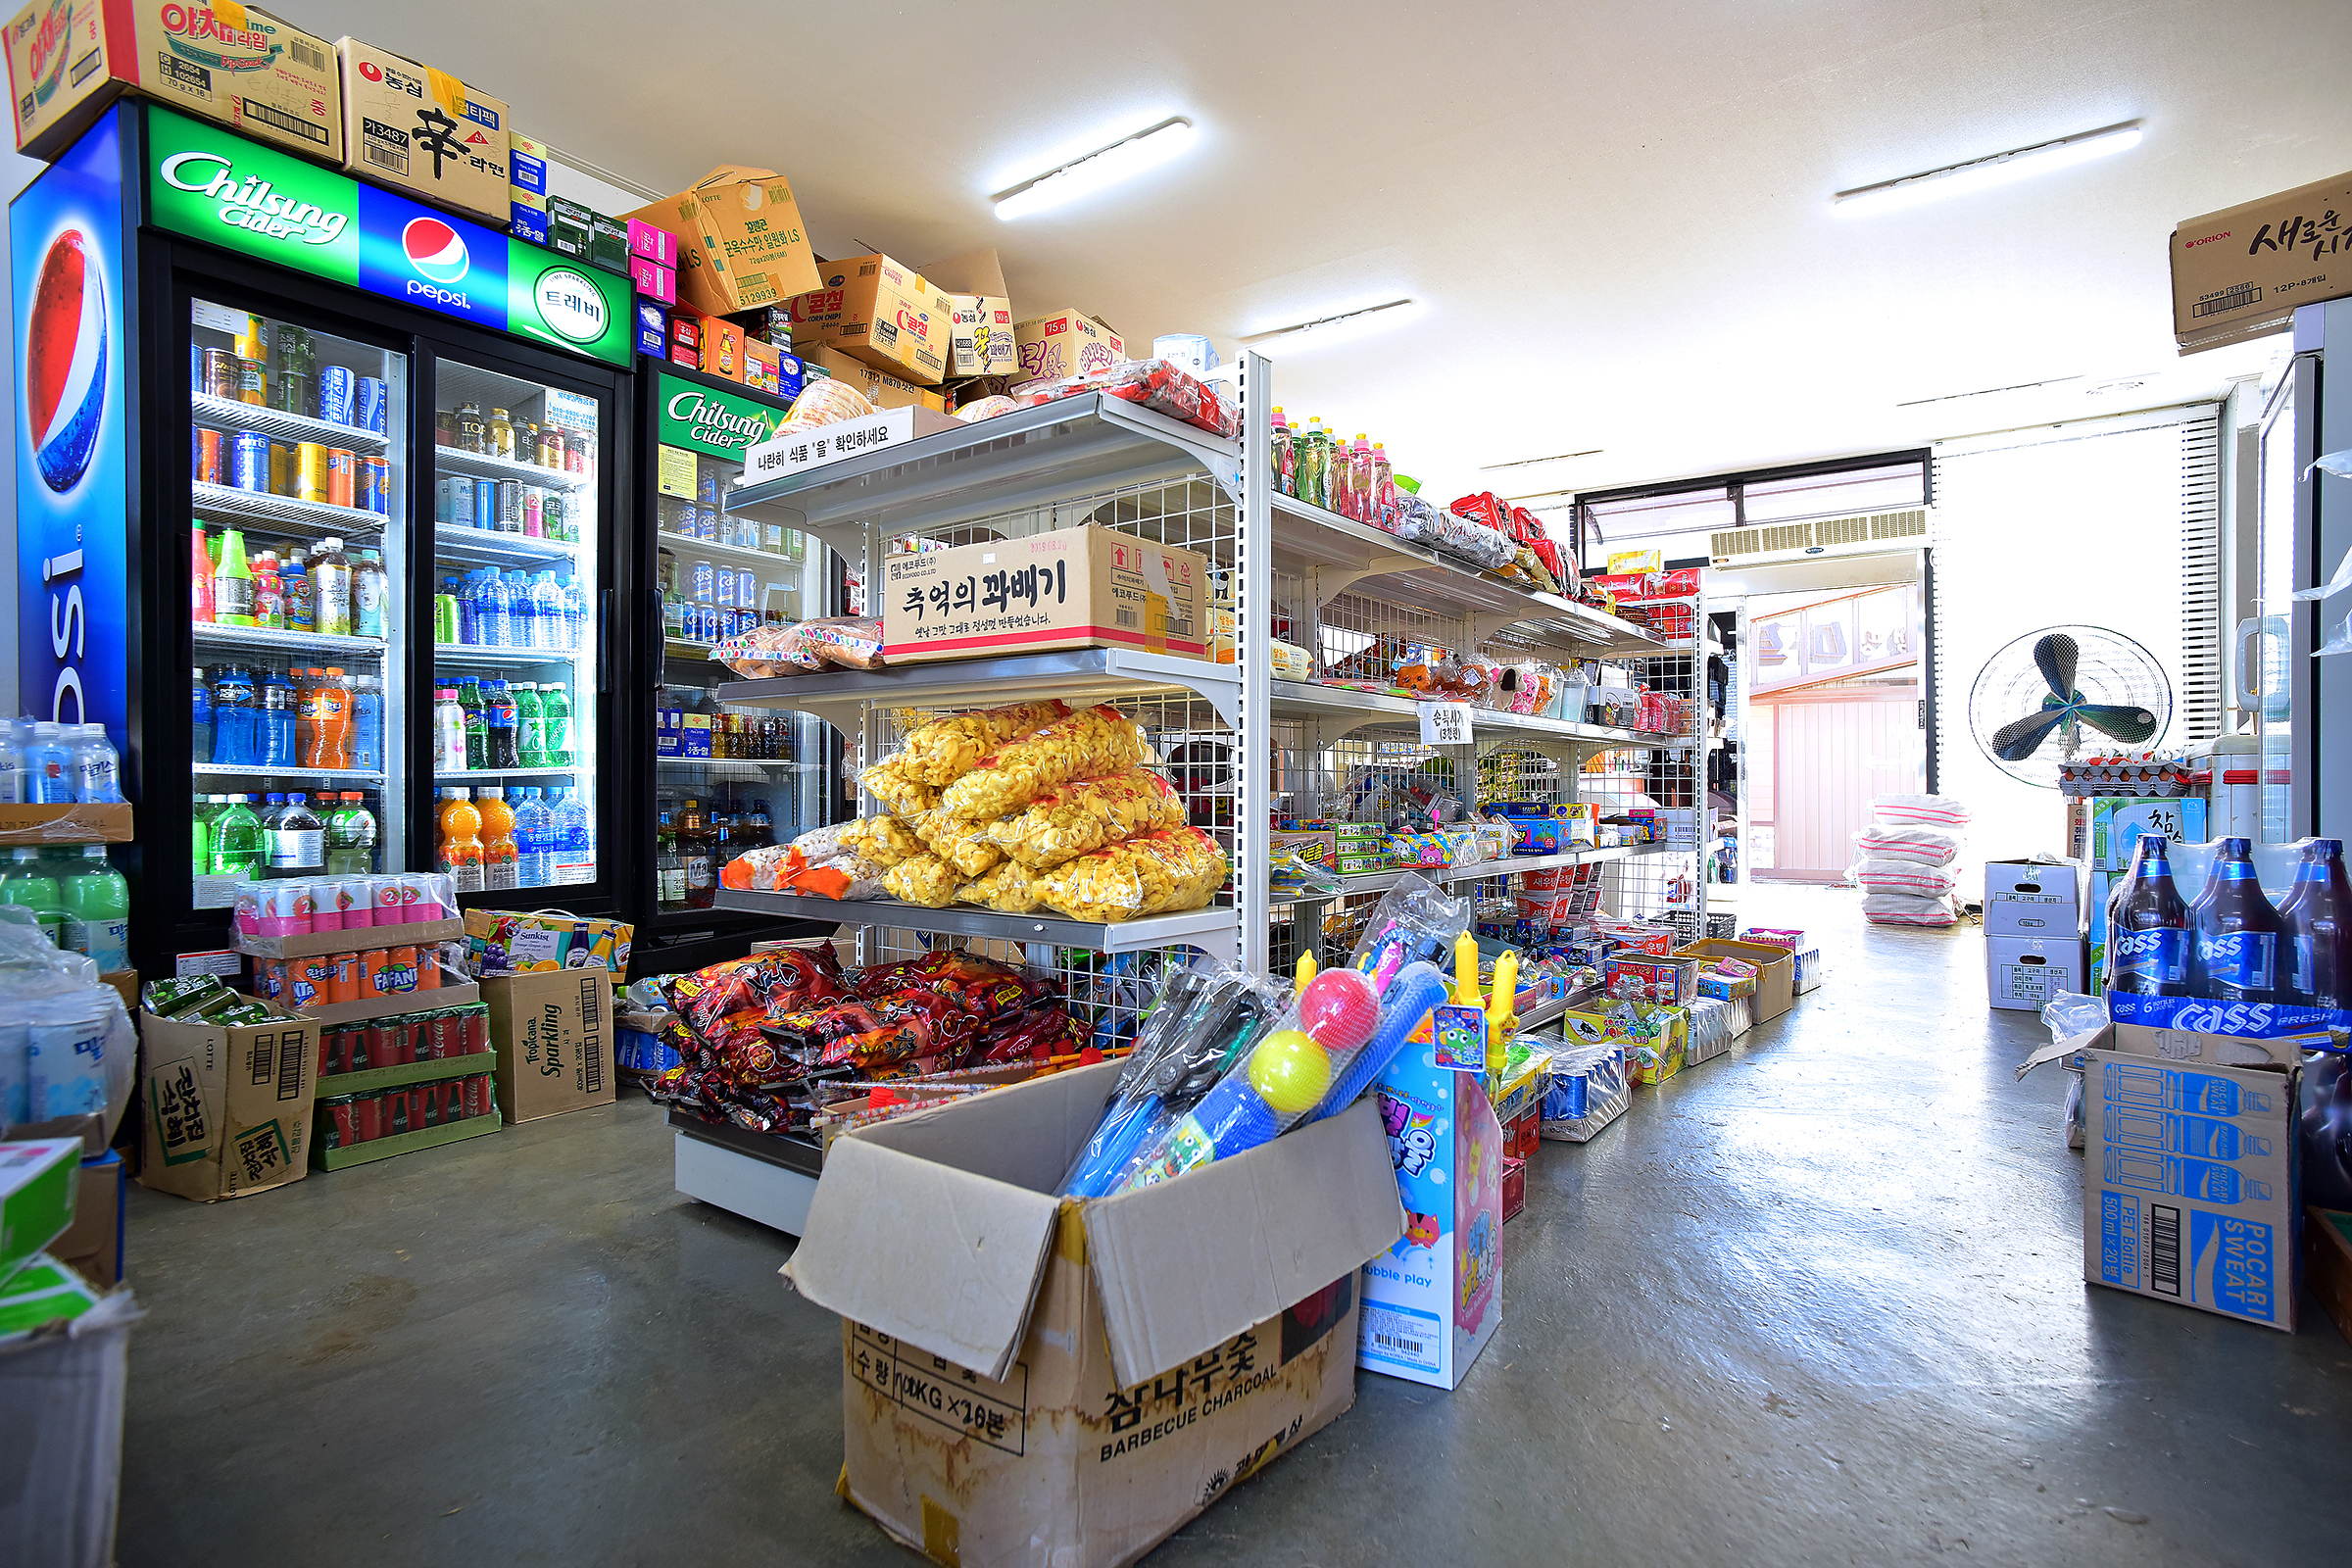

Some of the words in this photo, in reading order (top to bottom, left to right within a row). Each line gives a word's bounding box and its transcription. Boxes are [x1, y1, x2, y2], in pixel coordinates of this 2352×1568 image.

[246, 18, 276, 34] ime
[174, 71, 207, 87] 102654
[178, 61, 200, 76] 2654
[168, 77, 178, 87] 70
[195, 88, 205, 98] 16
[384, 73, 422, 99] 농심
[365, 120, 408, 144] 가3487
[412, 108, 471, 181] 辛
[469, 155, 506, 179] 라면
[160, 151, 349, 245] Chilsung
[702, 194, 721, 203] LOTTE
[218, 205, 306, 242] Cider
[788, 228, 801, 243] LS
[2197, 231, 2230, 246] ORION
[407, 279, 466, 309] pepsi
[739, 287, 777, 306] 5129939
[808, 290, 845, 315] 콘칩
[546, 291, 600, 322] 트레비
[808, 314, 824, 322] CORN
[824, 312, 842, 321] CHIPS
[907, 316, 928, 337] 콘칩
[1047, 323, 1058, 334] 75
[882, 375, 901, 390] M870
[667, 392, 767, 450] Chilsung
[690, 426, 747, 449] Cider
[758, 452, 784, 471] 나란히
[789, 446, 808, 463] 식품
[835, 425, 889, 452] 확인하세요
[903, 556, 937, 572] 에코푸드(주)
[903, 575, 976, 621] 추억의
[982, 559, 1066, 613] 꽈배기
[1111, 587, 1147, 604] 에코푸드(주
[43, 549, 85, 723] psi
[915, 625, 931, 639] 옛날
[932, 623, 947, 637] 그맛
[949, 621, 970, 635] 그대로
[999, 612, 1051, 629] 만들었습니다.
[1534, 877, 1556, 887] 새우탕
[1558, 874, 1571, 885] 우탕
[520, 932, 550, 942] Sunkist
[1647, 942, 1664, 954] 우탕
[390, 968, 418, 985] FANT
[2143, 1002, 2153, 1013] 6
[2277, 1012, 2333, 1026] FRESH
[541, 1004, 563, 1077] Sparkling
[176, 1064, 205, 1142] 잔치집
[2211, 1079, 2220, 1110] SWEAT
[161, 1079, 186, 1148] 식혜
[2211, 1166, 2220, 1198] SWEAT
[2123, 1205, 2136, 1227] PET
[2122, 1230, 2137, 1275] Bottle
[2224, 1219, 2245, 1303] SWEAT
[1404, 1273, 1432, 1289] play
[2246, 1223, 2267, 1316] POCARI
[1101, 1406, 1197, 1462] BARBECUE
[1202, 1363, 1277, 1417] CHARCOAL
